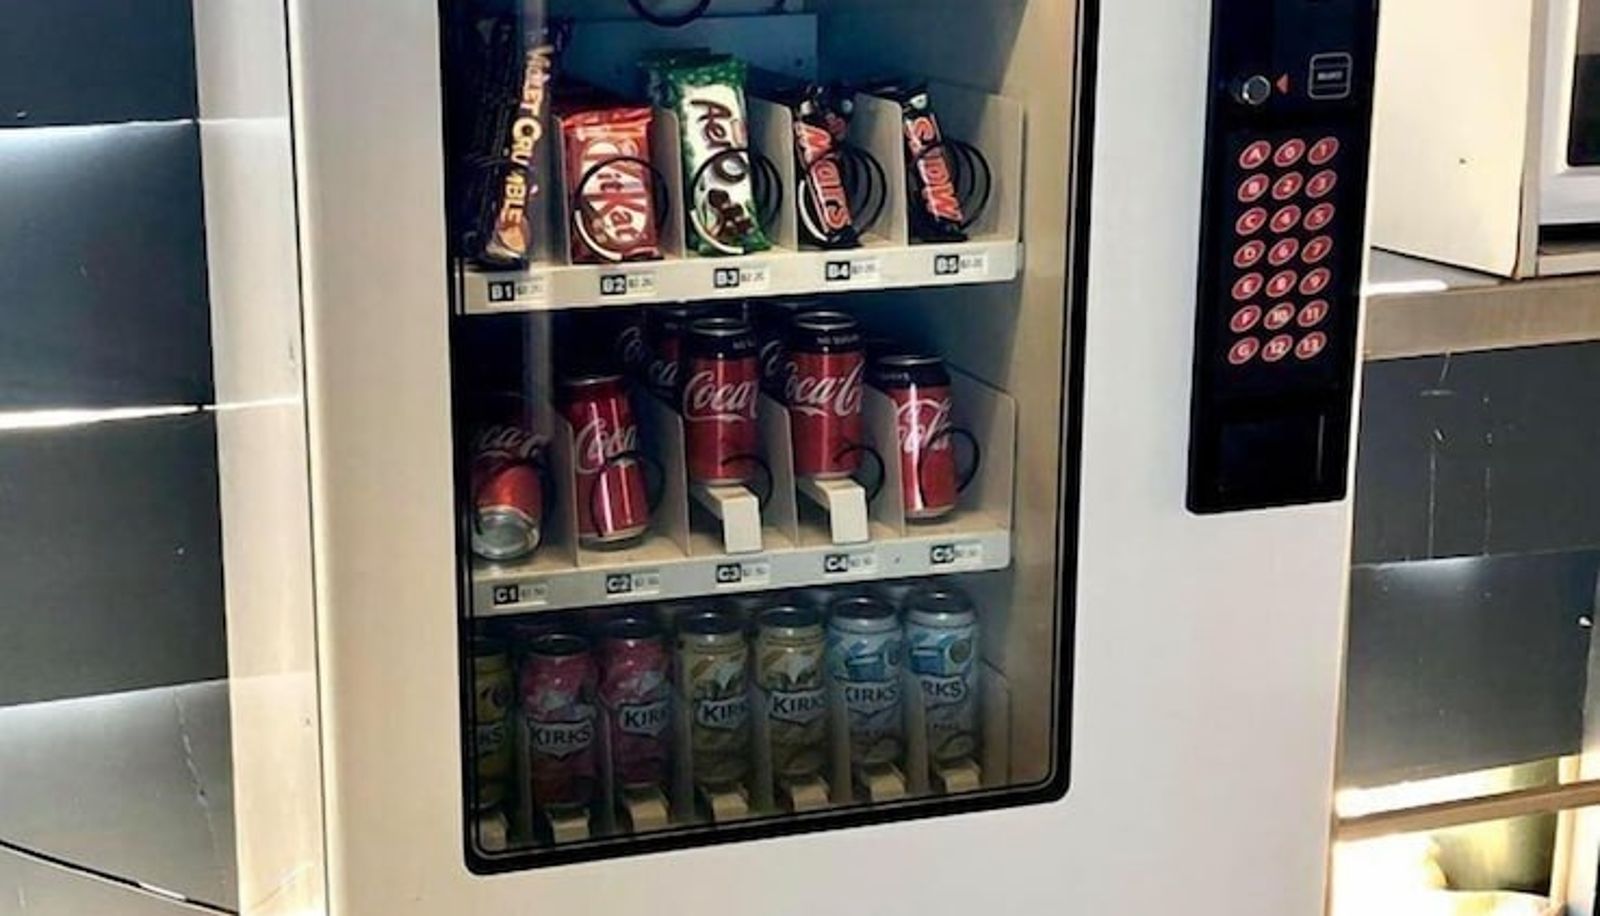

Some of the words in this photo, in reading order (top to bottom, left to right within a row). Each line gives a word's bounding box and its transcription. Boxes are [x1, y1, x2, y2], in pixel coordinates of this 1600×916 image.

[828, 264, 849, 279] B4
[936, 257, 957, 272] B5
[602, 277, 625, 293] B2
[716, 270, 738, 285] B3
[491, 284, 513, 300] B1
[932, 547, 953, 561] C5
[826, 557, 847, 571] C4
[718, 565, 740, 580] C3
[607, 577, 629, 592] C2
[496, 586, 517, 602] C1
[530, 727, 592, 746] KIRKS
